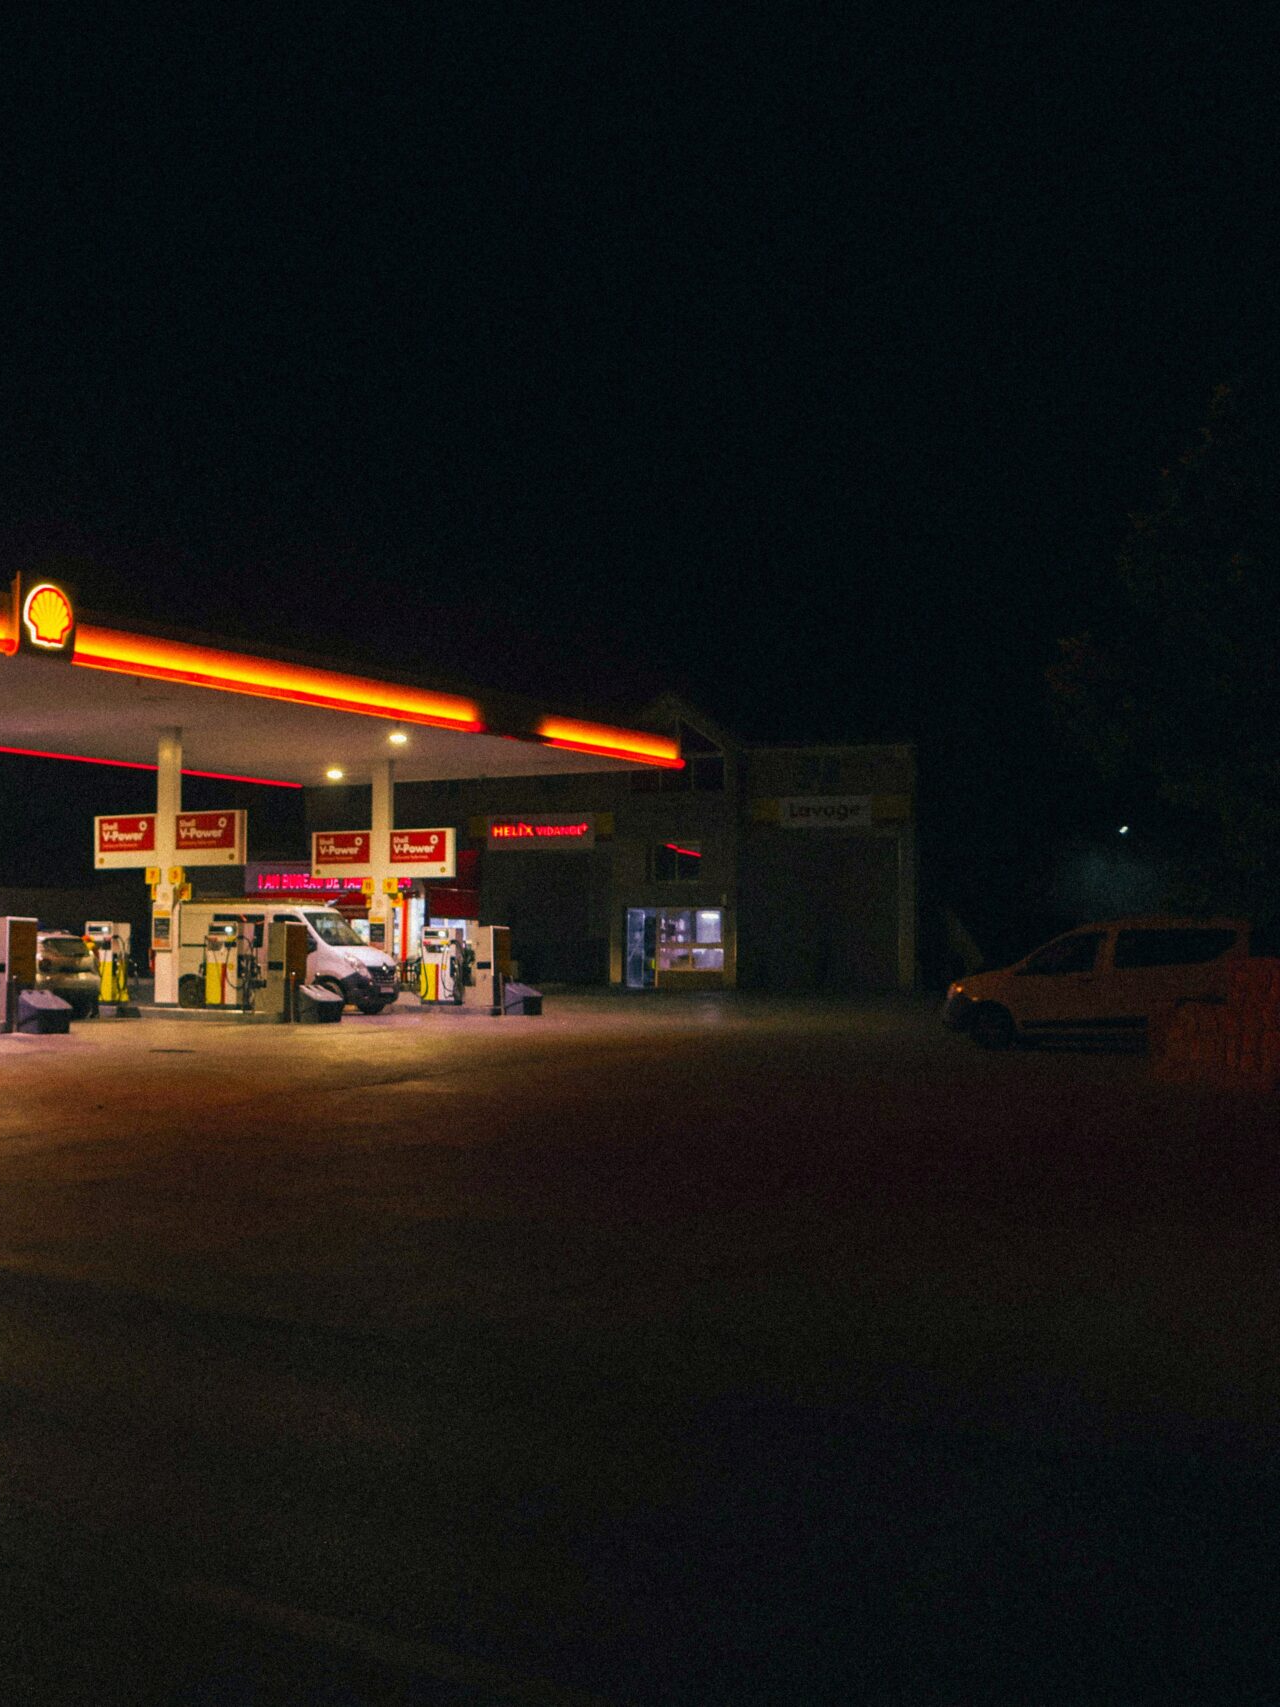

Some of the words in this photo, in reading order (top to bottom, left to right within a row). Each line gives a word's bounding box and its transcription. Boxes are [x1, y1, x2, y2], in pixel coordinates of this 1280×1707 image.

[788, 803, 861, 821] Lavage
[102, 822, 118, 831] Shell
[492, 822, 535, 838] HELIX
[102, 830, 145, 843] V-Power
[179, 827, 224, 840] V-Power
[393, 836, 409, 844] Shell
[320, 845, 360, 856] V-Power
[393, 843, 435, 855] V-Power
